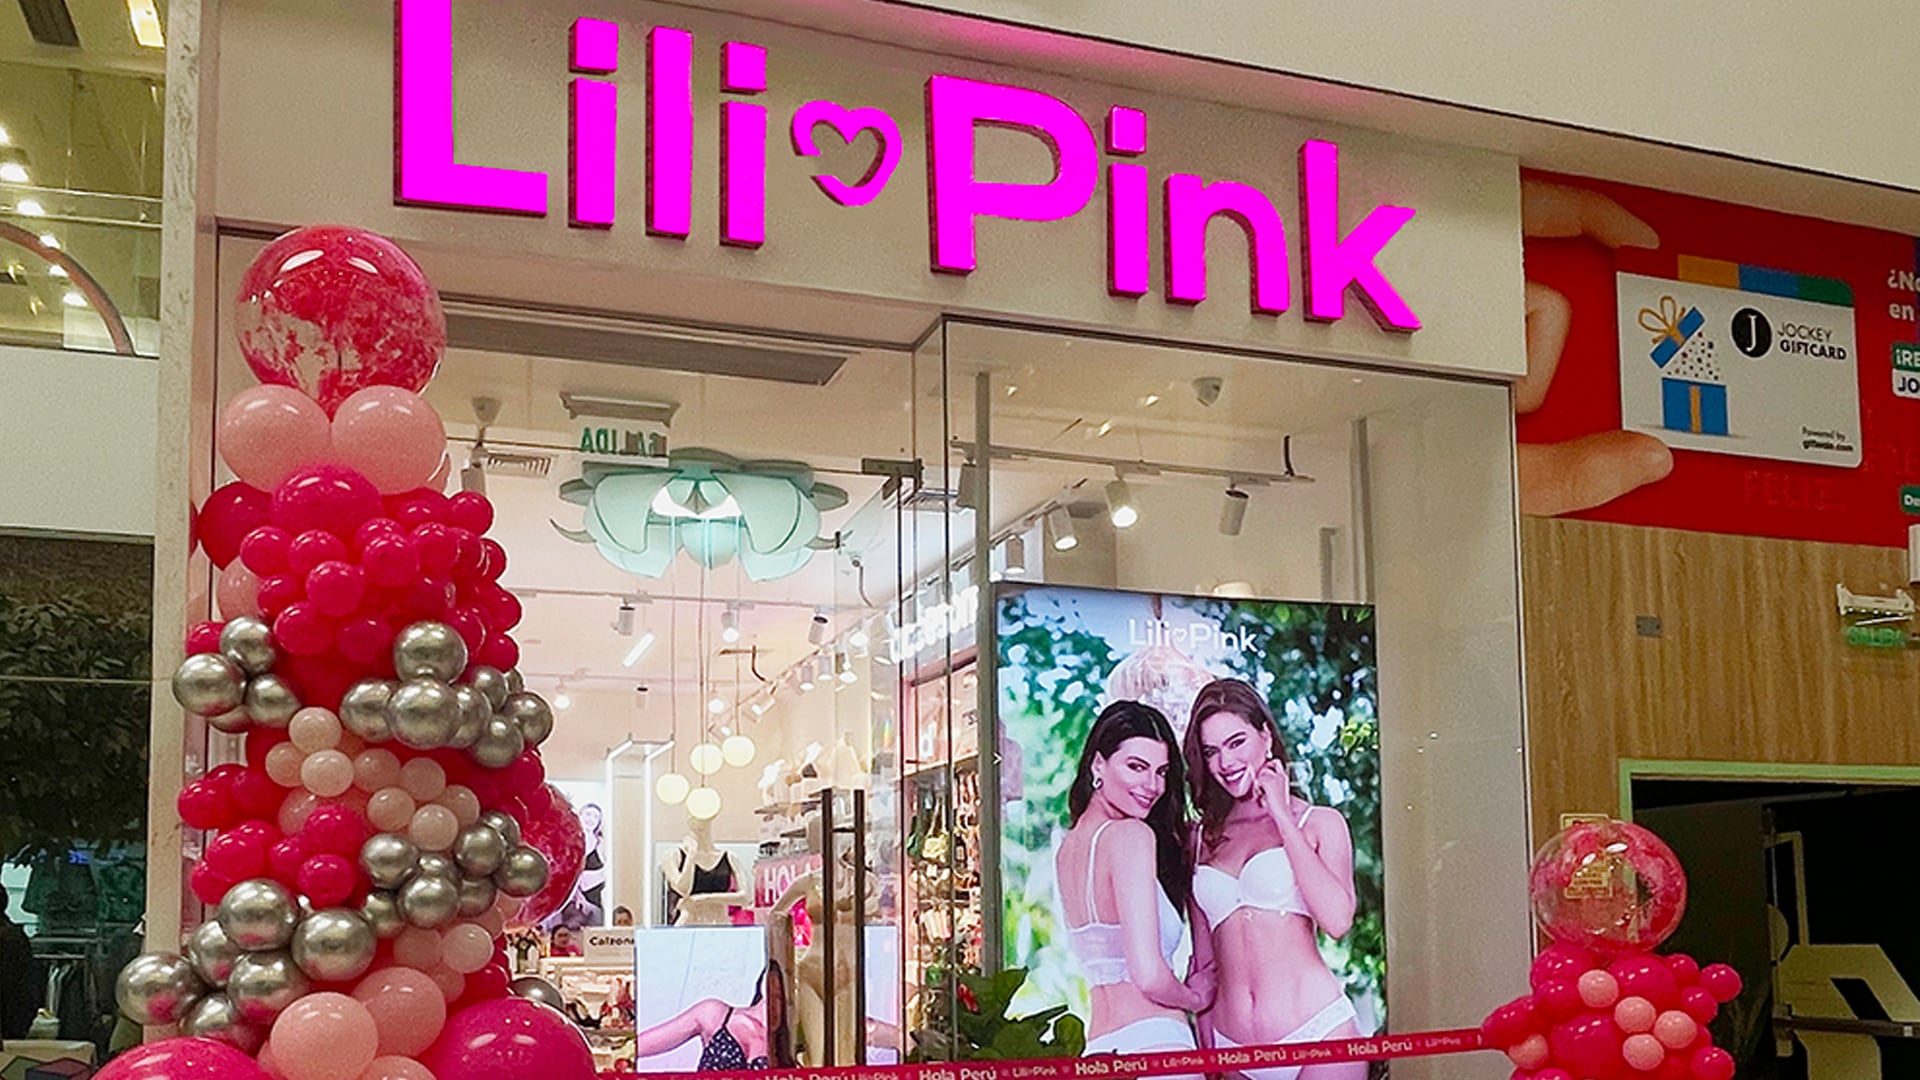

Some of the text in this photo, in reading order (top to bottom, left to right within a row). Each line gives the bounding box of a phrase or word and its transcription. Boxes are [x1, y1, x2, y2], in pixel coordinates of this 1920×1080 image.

[393, 0, 1423, 334] Lili Pink
[1889, 303, 1915, 321] en
[1777, 322, 1832, 342] JOCKEY
[1780, 340, 1847, 360] GIFTCARD
[1129, 618, 1259, 653] Lili Pink
[960, 1066, 997, 1080] Perú
[1075, 1061, 1109, 1075] Hola
[1113, 1057, 1147, 1073] Perú
[1218, 1051, 1250, 1065] Hola
[1254, 1047, 1287, 1061] Perú
[1347, 1041, 1378, 1056] Hola
[1381, 1038, 1413, 1053] Perú
